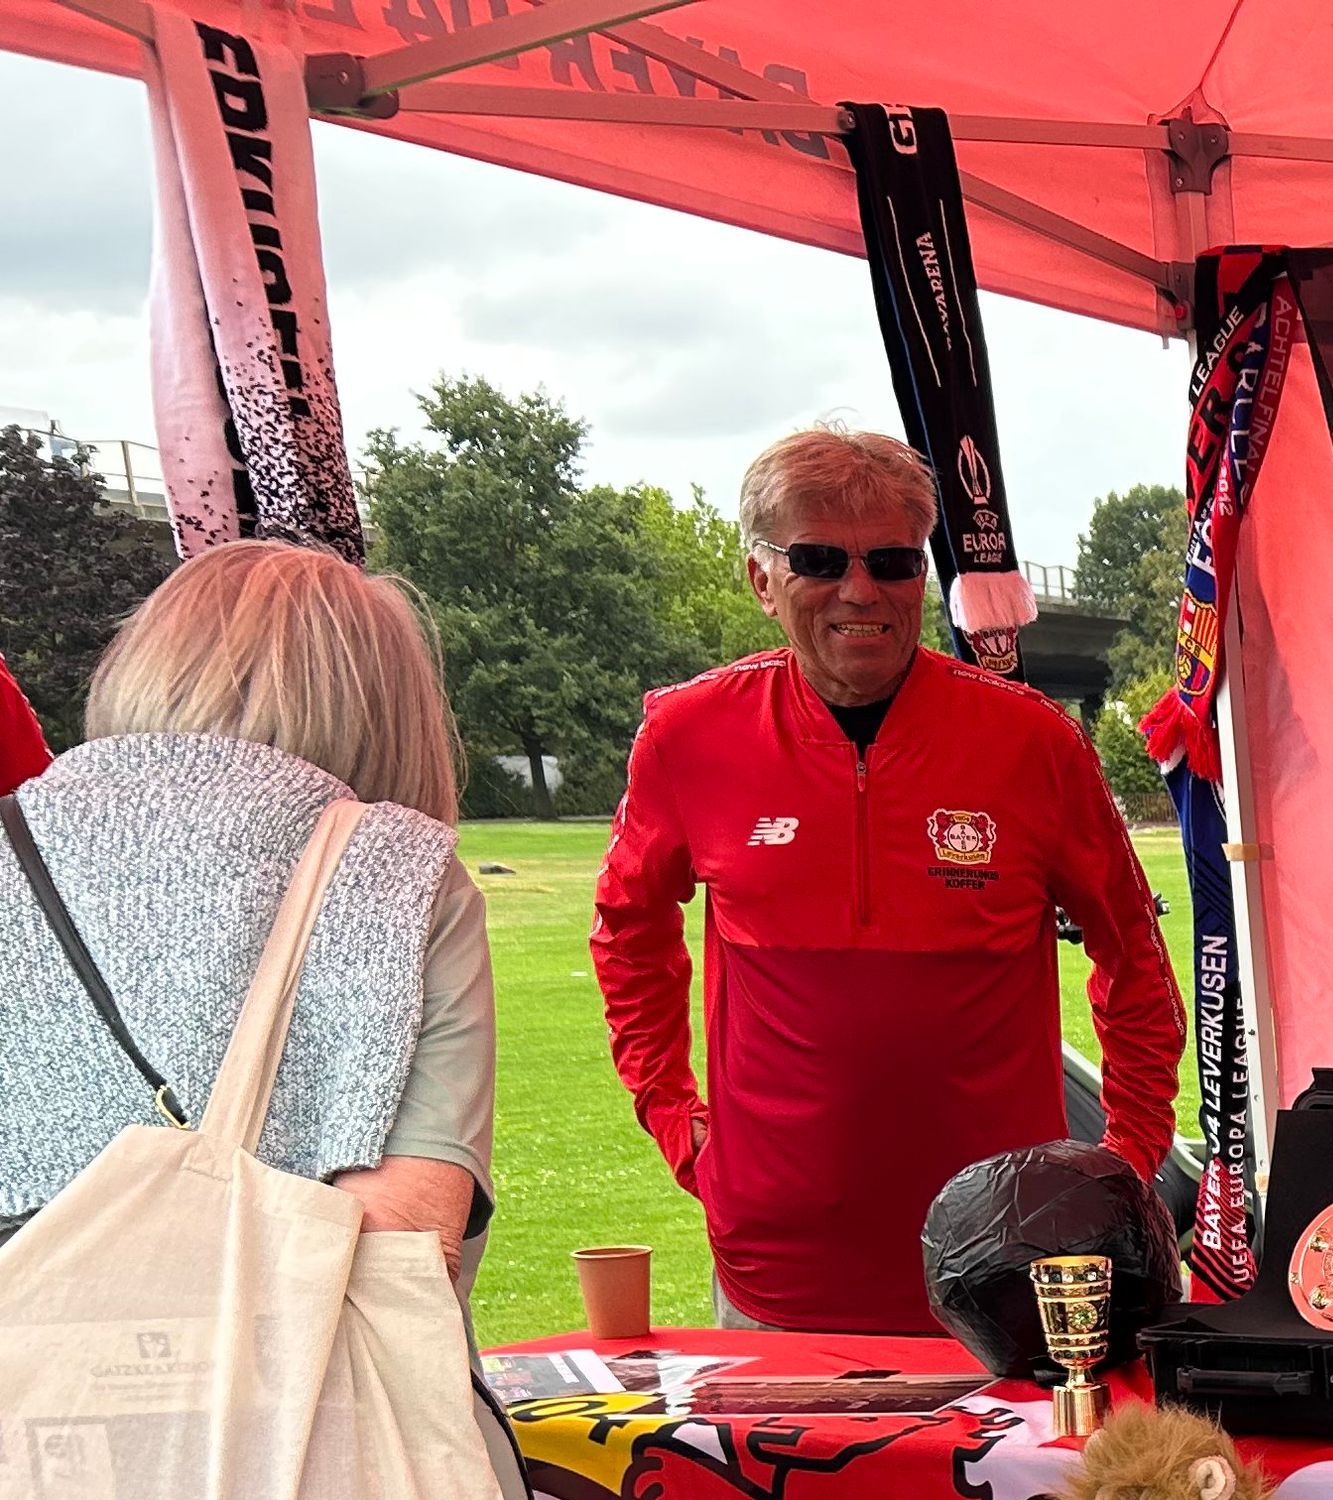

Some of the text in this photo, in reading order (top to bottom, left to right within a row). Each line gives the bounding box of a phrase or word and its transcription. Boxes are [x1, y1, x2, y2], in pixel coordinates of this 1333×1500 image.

[1191, 305, 1245, 398] LEAGUE
[1200, 934, 1228, 1113] LEVERKUSEN
[1201, 1157, 1224, 1250] BAYER
[1228, 1108, 1248, 1208] EUROPA
[1230, 1217, 1251, 1283] UEFA
